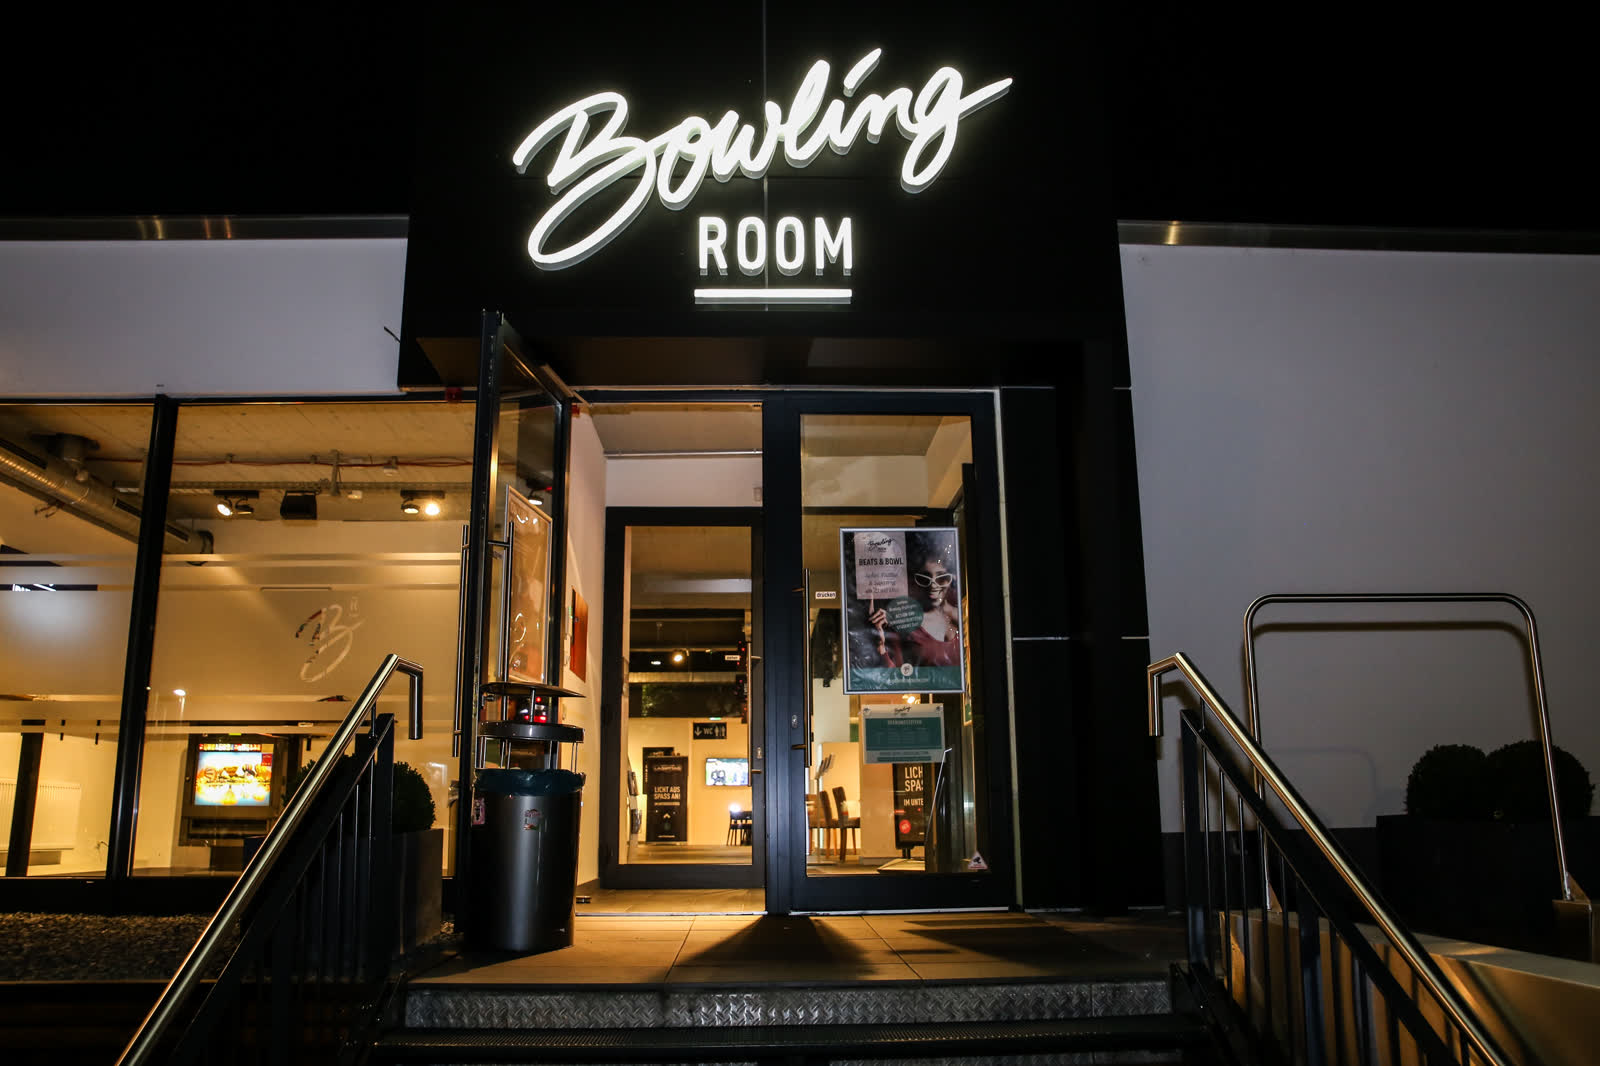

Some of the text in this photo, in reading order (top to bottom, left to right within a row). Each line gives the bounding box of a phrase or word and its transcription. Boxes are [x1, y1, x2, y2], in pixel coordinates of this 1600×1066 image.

[512, 47, 1013, 271] Bowling
[698, 216, 853, 276] ROOM
[858, 558, 878, 566] BEATS
[885, 558, 904, 566] BOWL
[703, 727, 713, 735] WC
[903, 799, 910, 807] IM
